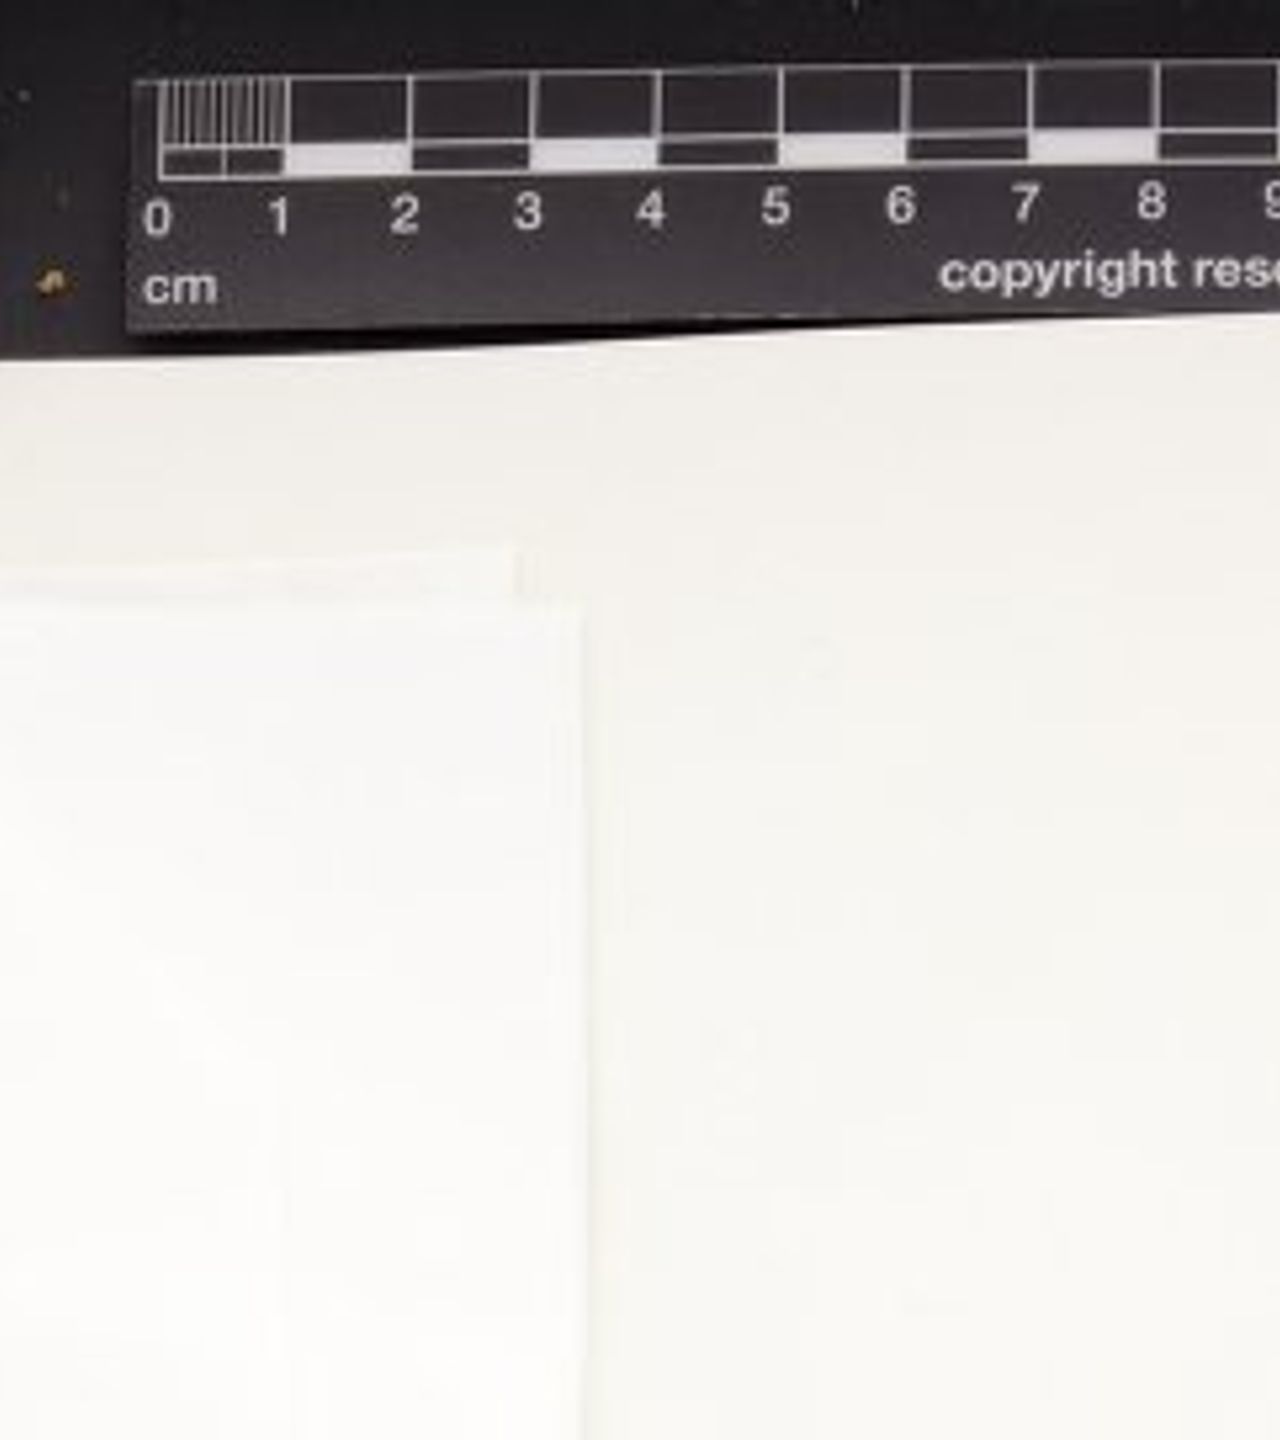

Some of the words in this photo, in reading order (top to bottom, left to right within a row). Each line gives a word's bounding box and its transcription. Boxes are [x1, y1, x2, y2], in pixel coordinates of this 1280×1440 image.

[143, 200, 172, 237] 0
[269, 197, 288, 235] 1
[390, 193, 419, 234] 2
[514, 190, 542, 230] 3
[636, 189, 666, 227] 4
[762, 185, 791, 225] 5
[886, 184, 916, 224] 6
[1011, 182, 1039, 222] 7
[1138, 181, 1167, 219] 8
[143, 273, 217, 305] cm
[939, 249, 1177, 298] copyright
